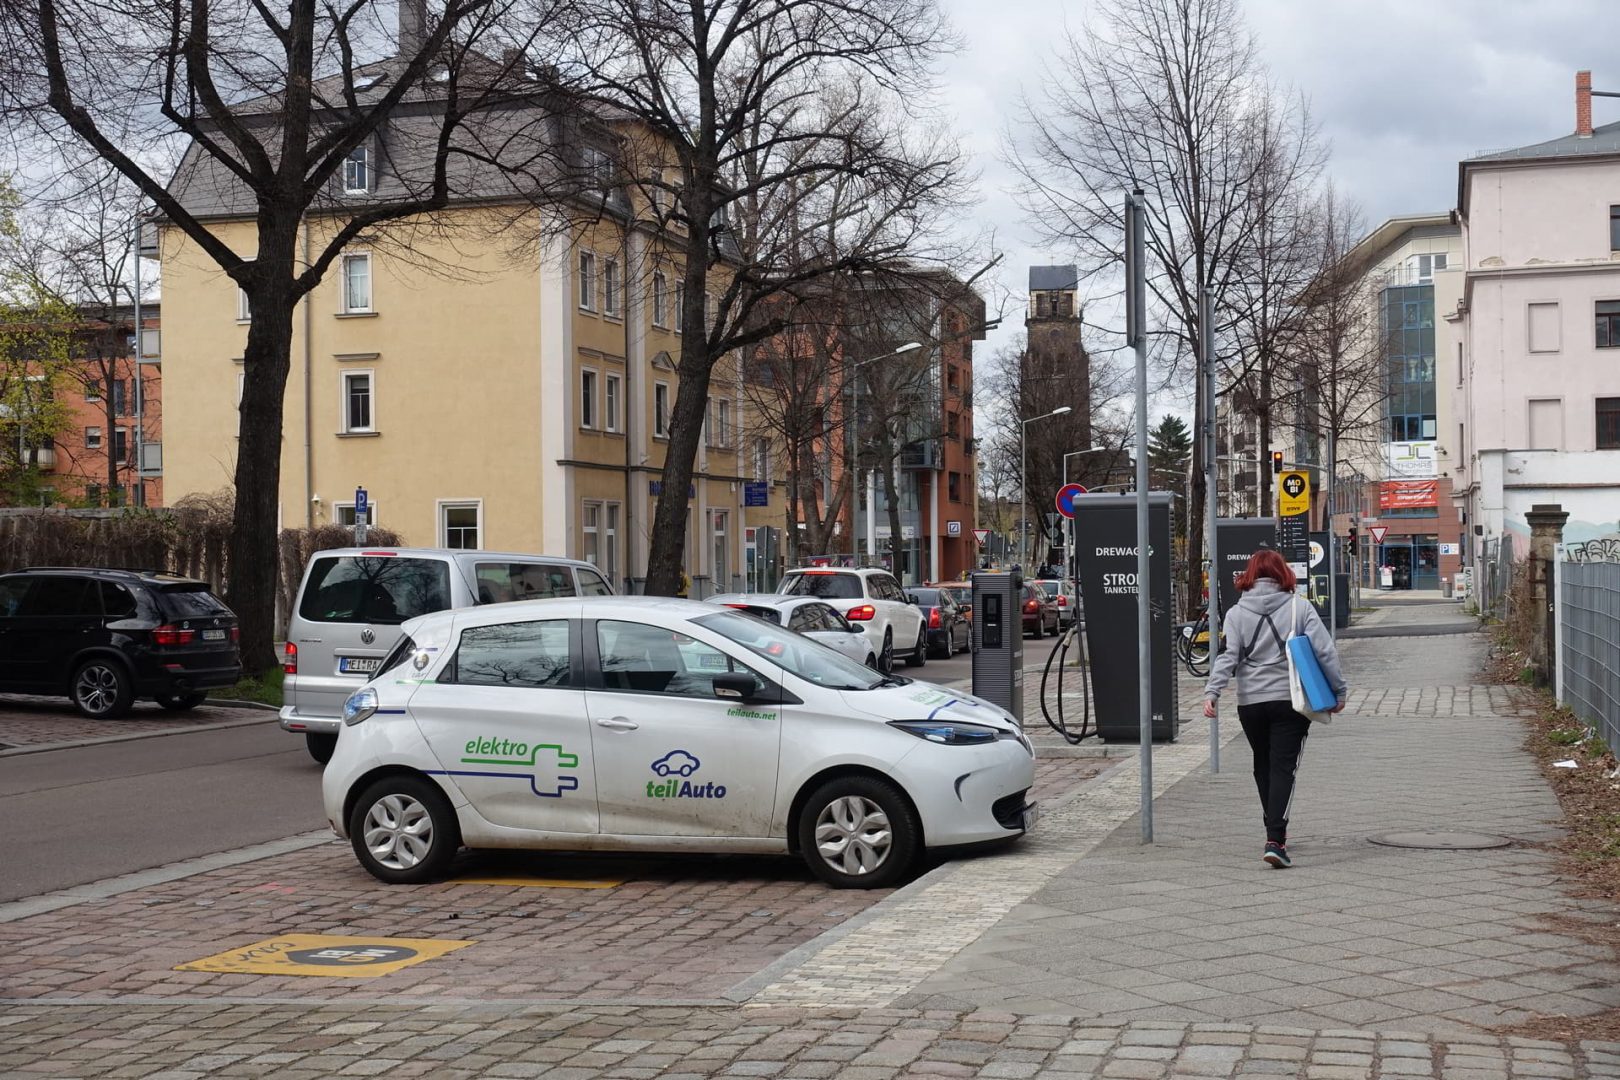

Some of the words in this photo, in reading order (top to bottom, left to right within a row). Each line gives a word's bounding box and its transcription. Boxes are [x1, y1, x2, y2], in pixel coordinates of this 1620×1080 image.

[1103, 573, 1139, 586] STRO
[1104, 586, 1139, 594] TANKSTEL
[347, 658, 363, 671] MEI
[727, 708, 777, 720] teilauto.net
[465, 735, 528, 756] elektro
[646, 779, 727, 798] teilAuto
